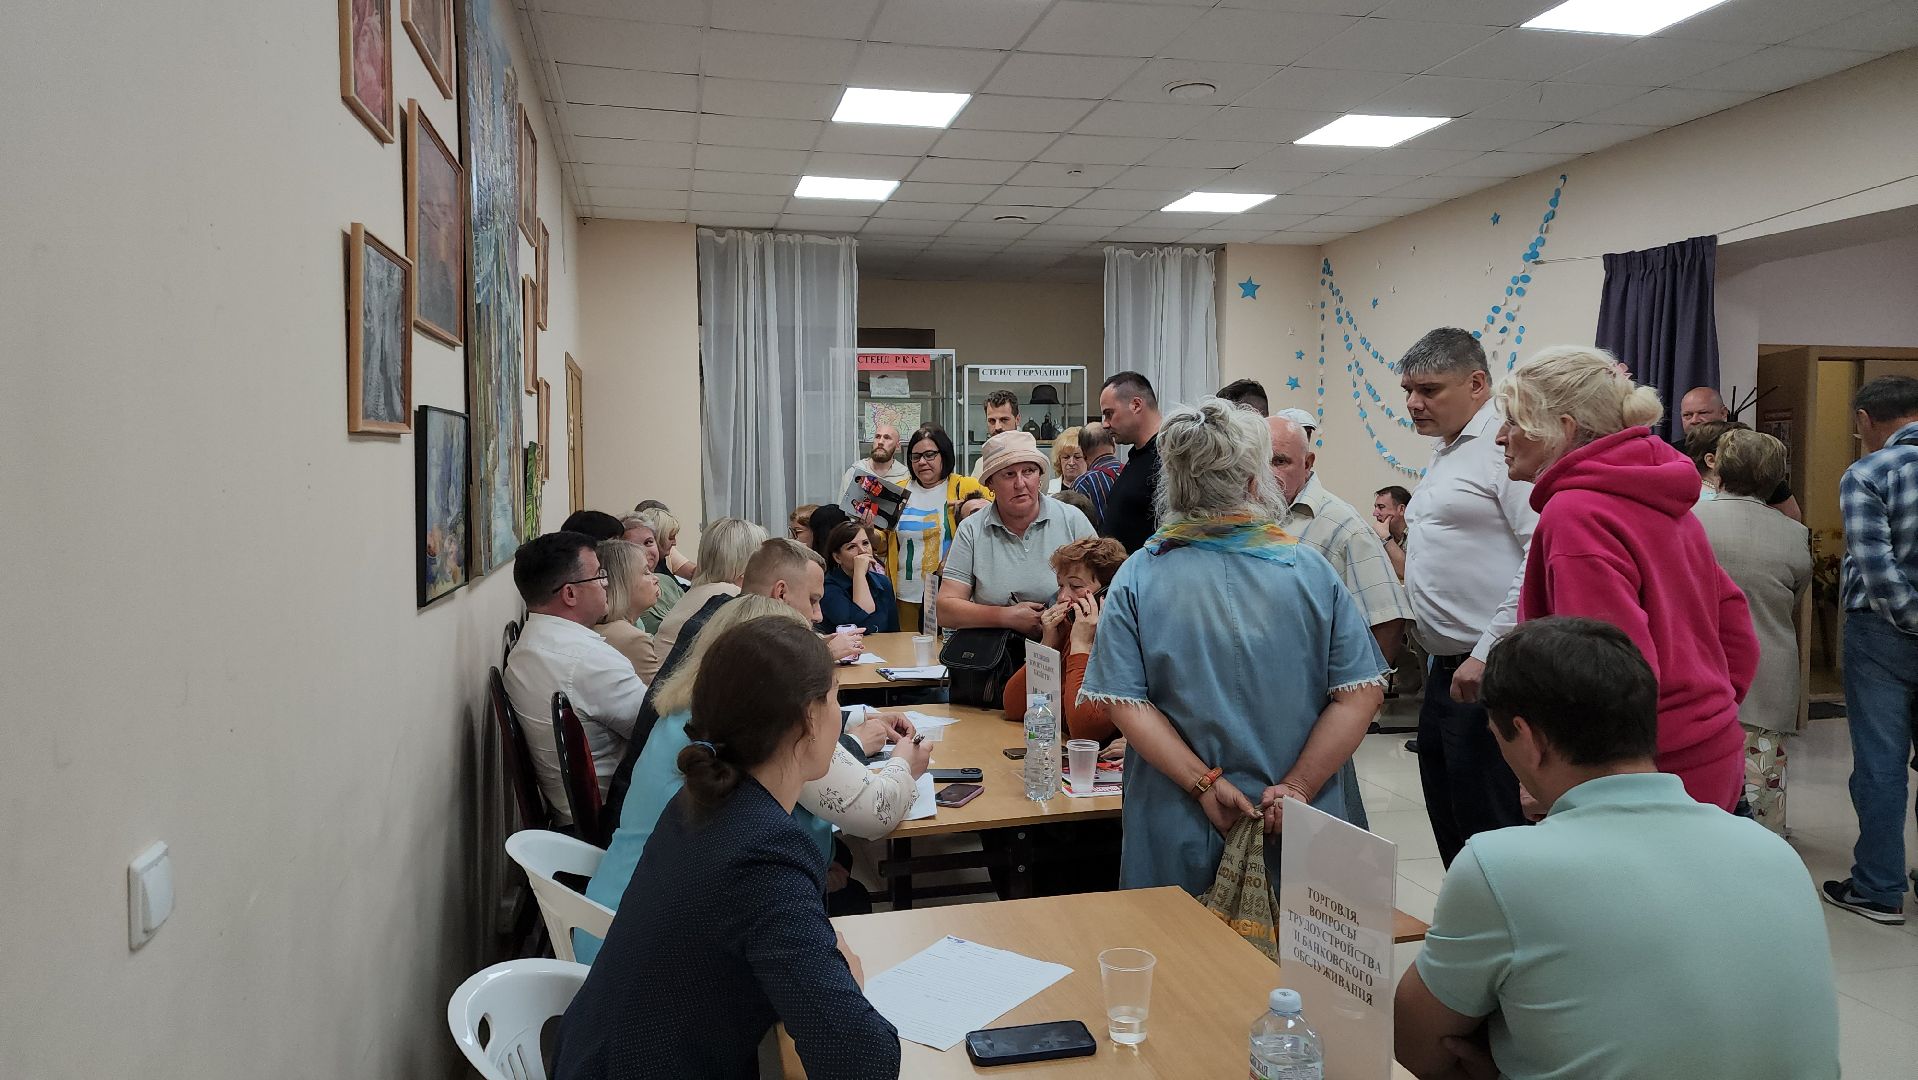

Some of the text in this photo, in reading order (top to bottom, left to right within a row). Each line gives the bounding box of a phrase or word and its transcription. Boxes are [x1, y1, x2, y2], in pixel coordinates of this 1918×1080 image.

[857, 355, 890, 365] СТЕНД
[1017, 369, 1069, 377] ГЕРМАНИИ
[1307, 886, 1360, 926] ТОРГОВЛЯ,
[1309, 905, 1357, 941] ВОПРОСЫ
[1287, 908, 1382, 975] ТРУДОУСТРОЙСТВА
[1294, 930, 1374, 987] И БАНКОВСКОГО
[1293, 946, 1375, 1008] ОБСЛУЖИВАНИЯ
